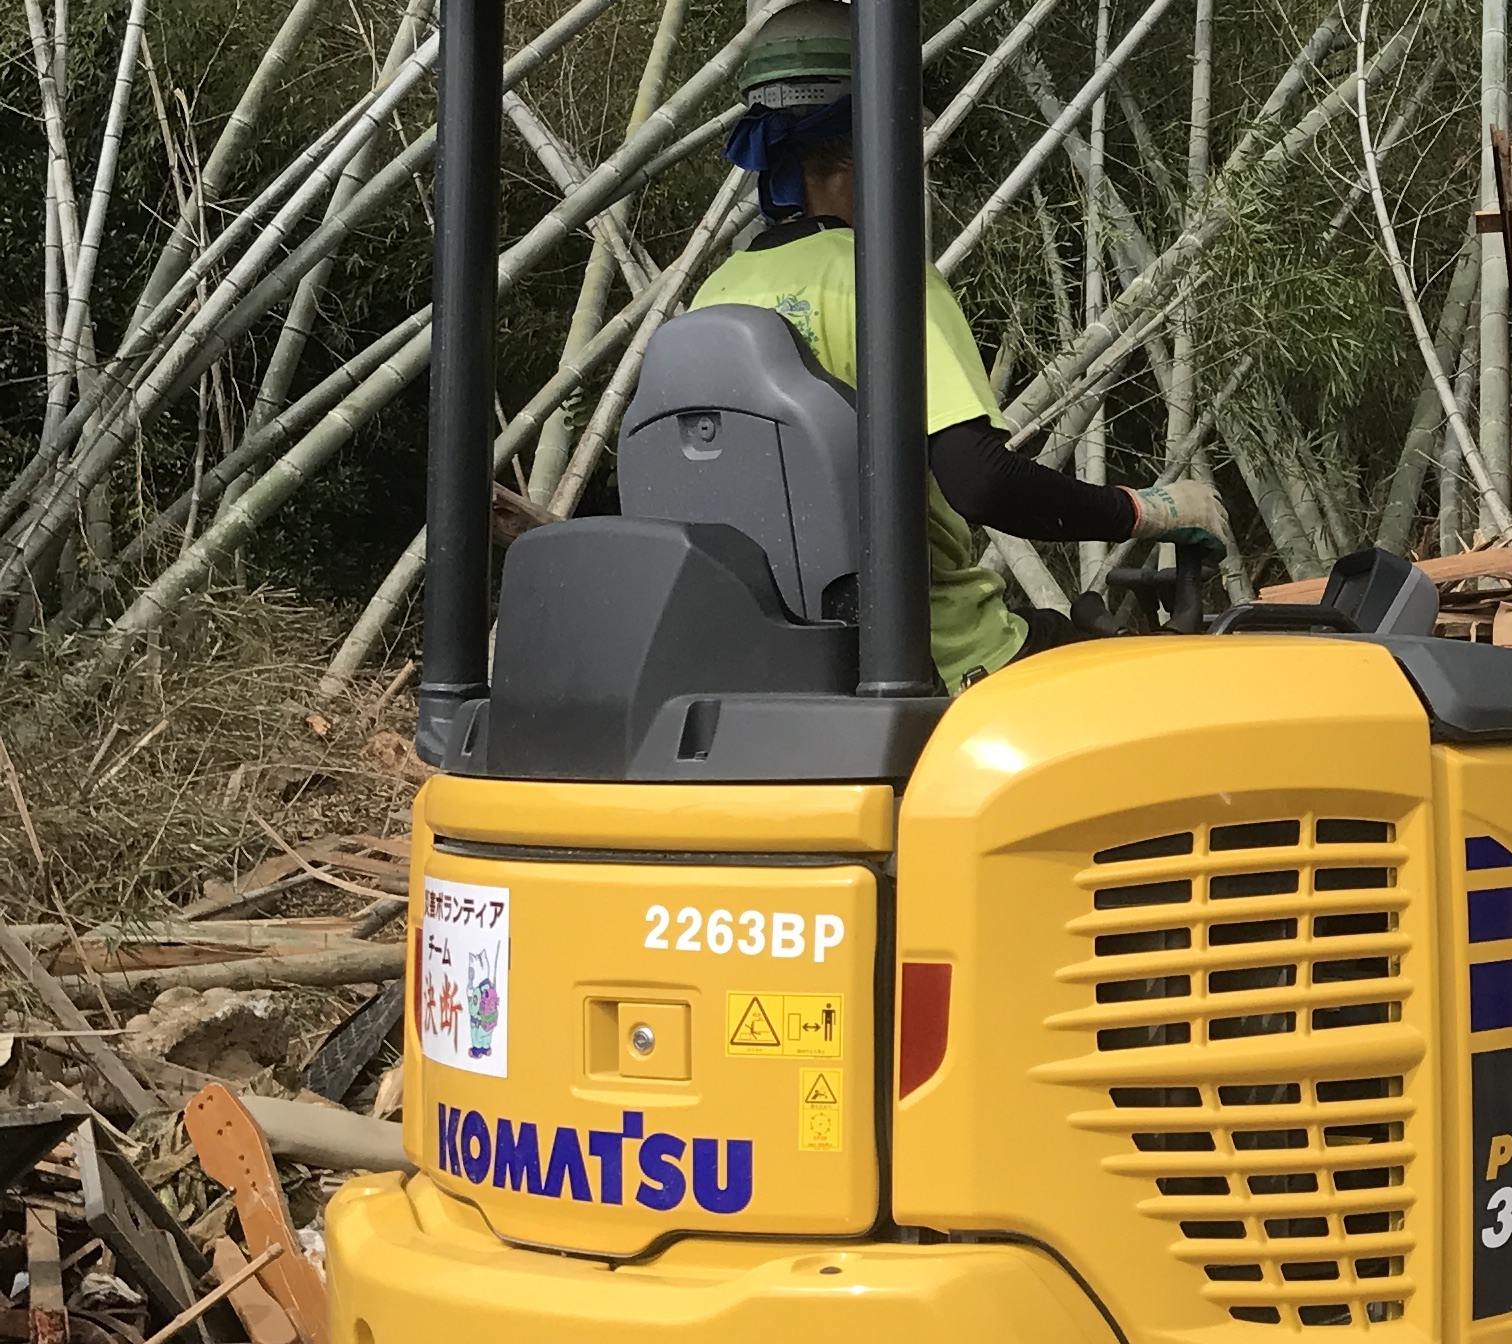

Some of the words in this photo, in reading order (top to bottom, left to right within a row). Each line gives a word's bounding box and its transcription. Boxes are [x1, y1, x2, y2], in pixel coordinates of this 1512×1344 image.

[428, 934, 452, 966] チーム
[644, 904, 845, 963] 2263BP
[424, 970, 463, 1053] 決断
[437, 1102, 754, 1215] KOMATSU
